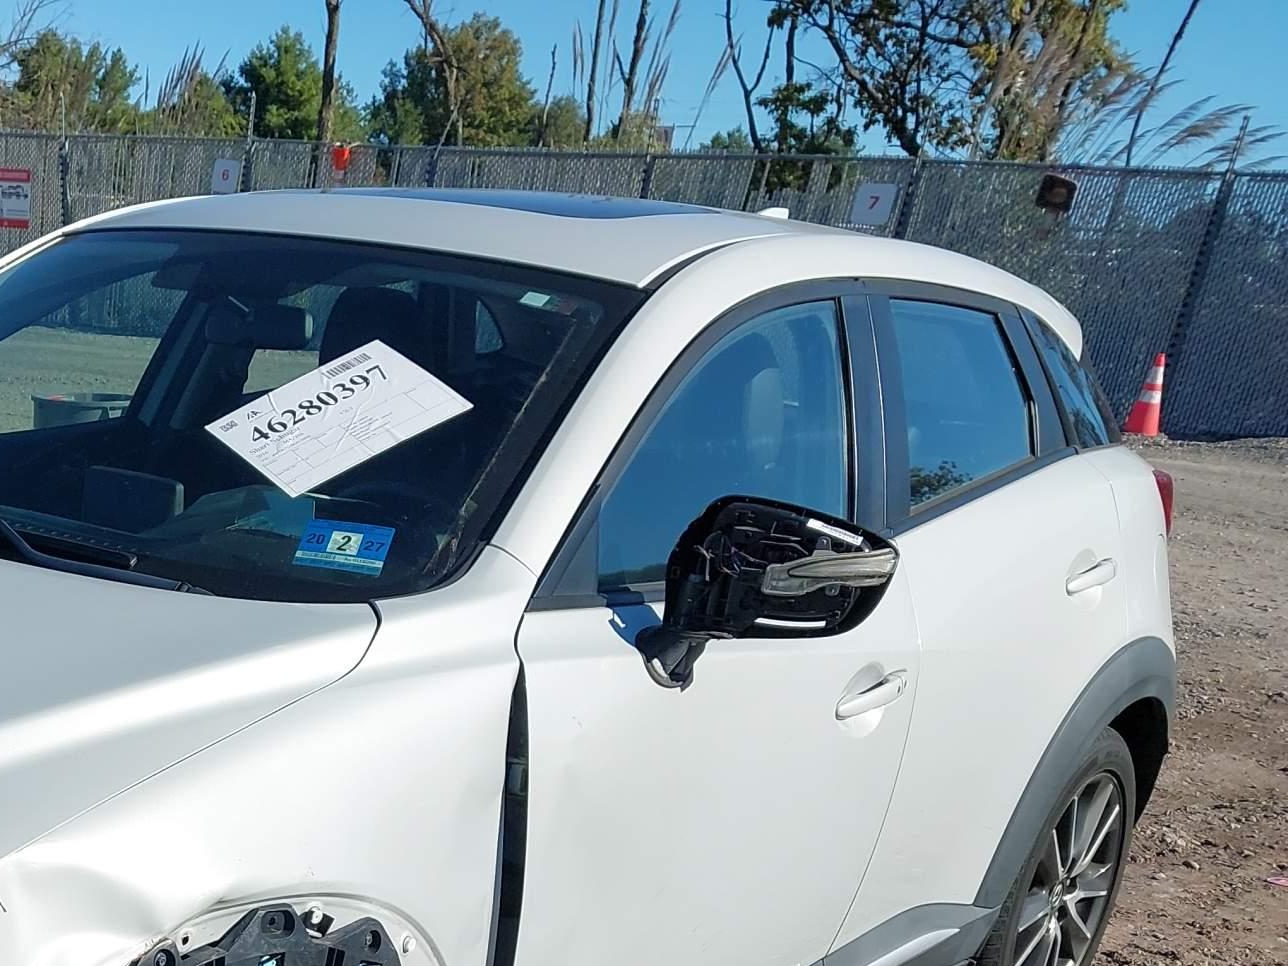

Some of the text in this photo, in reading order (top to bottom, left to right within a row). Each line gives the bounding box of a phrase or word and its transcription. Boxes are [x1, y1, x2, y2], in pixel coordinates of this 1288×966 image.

[222, 168, 230, 181] 6
[869, 195, 880, 210] 7
[252, 364, 388, 442] 46280397
[306, 532, 385, 553] 20 2 27
